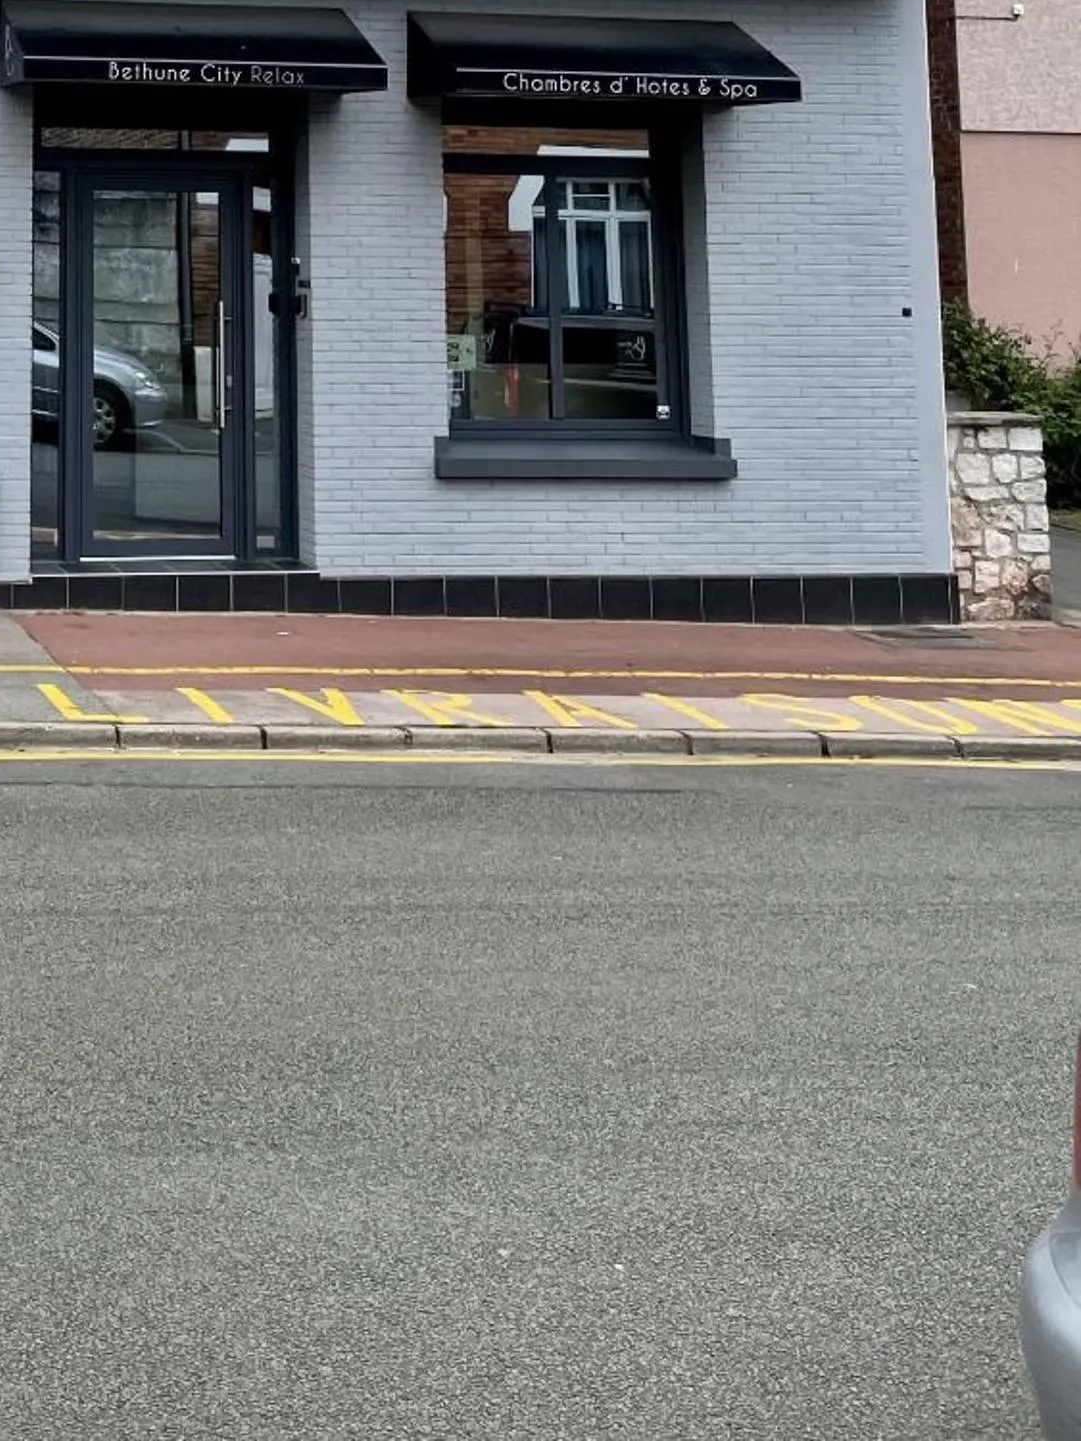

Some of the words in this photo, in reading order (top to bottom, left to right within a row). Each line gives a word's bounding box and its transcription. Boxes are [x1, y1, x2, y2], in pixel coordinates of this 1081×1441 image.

[108, 61, 191, 82] Bethune
[200, 63, 242, 85] City
[250, 65, 305, 85] Relax
[503, 72, 601, 93] Chambres
[698, 78, 711, 96] &
[719, 78, 758, 100] Spa
